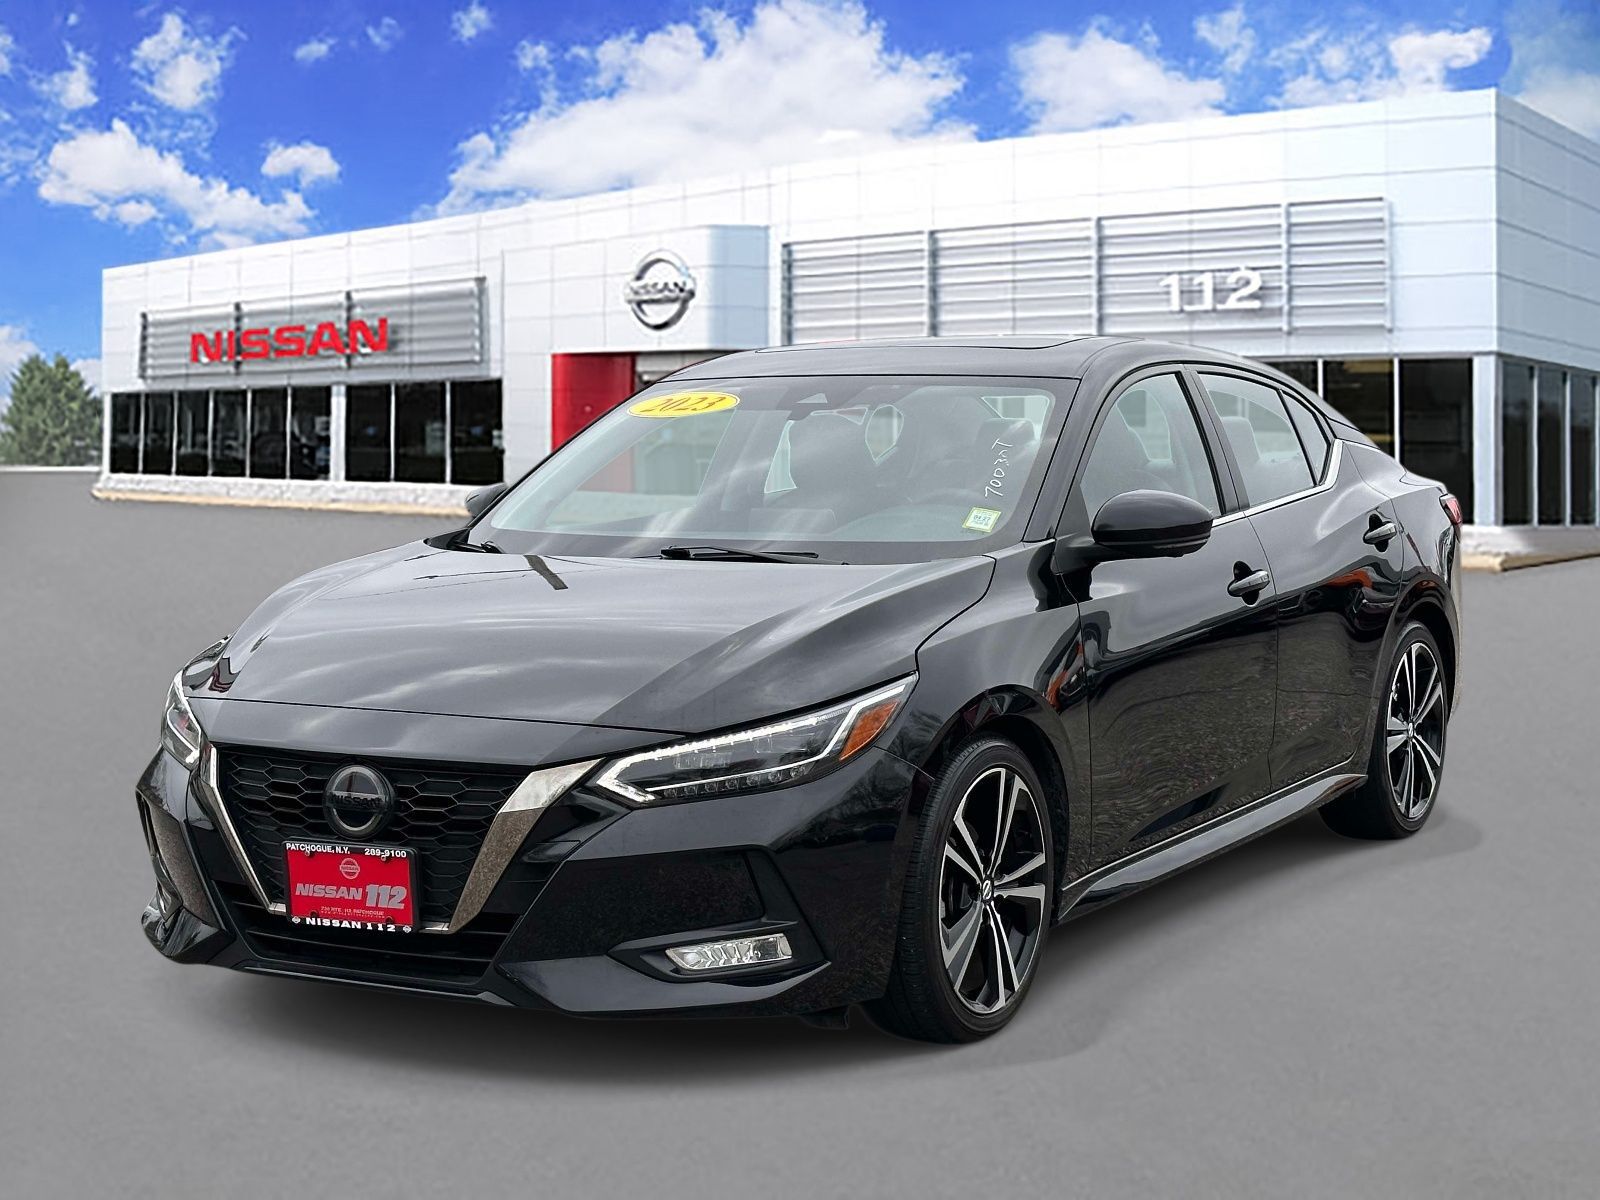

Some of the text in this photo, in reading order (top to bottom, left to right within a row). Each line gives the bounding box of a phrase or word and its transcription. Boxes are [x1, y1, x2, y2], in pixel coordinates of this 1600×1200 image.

[626, 280, 687, 298] NISSAN
[1159, 269, 1262, 312] 112
[190, 316, 388, 363] NISSAN
[640, 396, 727, 413] 2023
[286, 843, 407, 858] PATCHOGUE, N.Y. 289-9100
[295, 883, 407, 910] NISSAN 112
[305, 917, 362, 929] NISSAN
